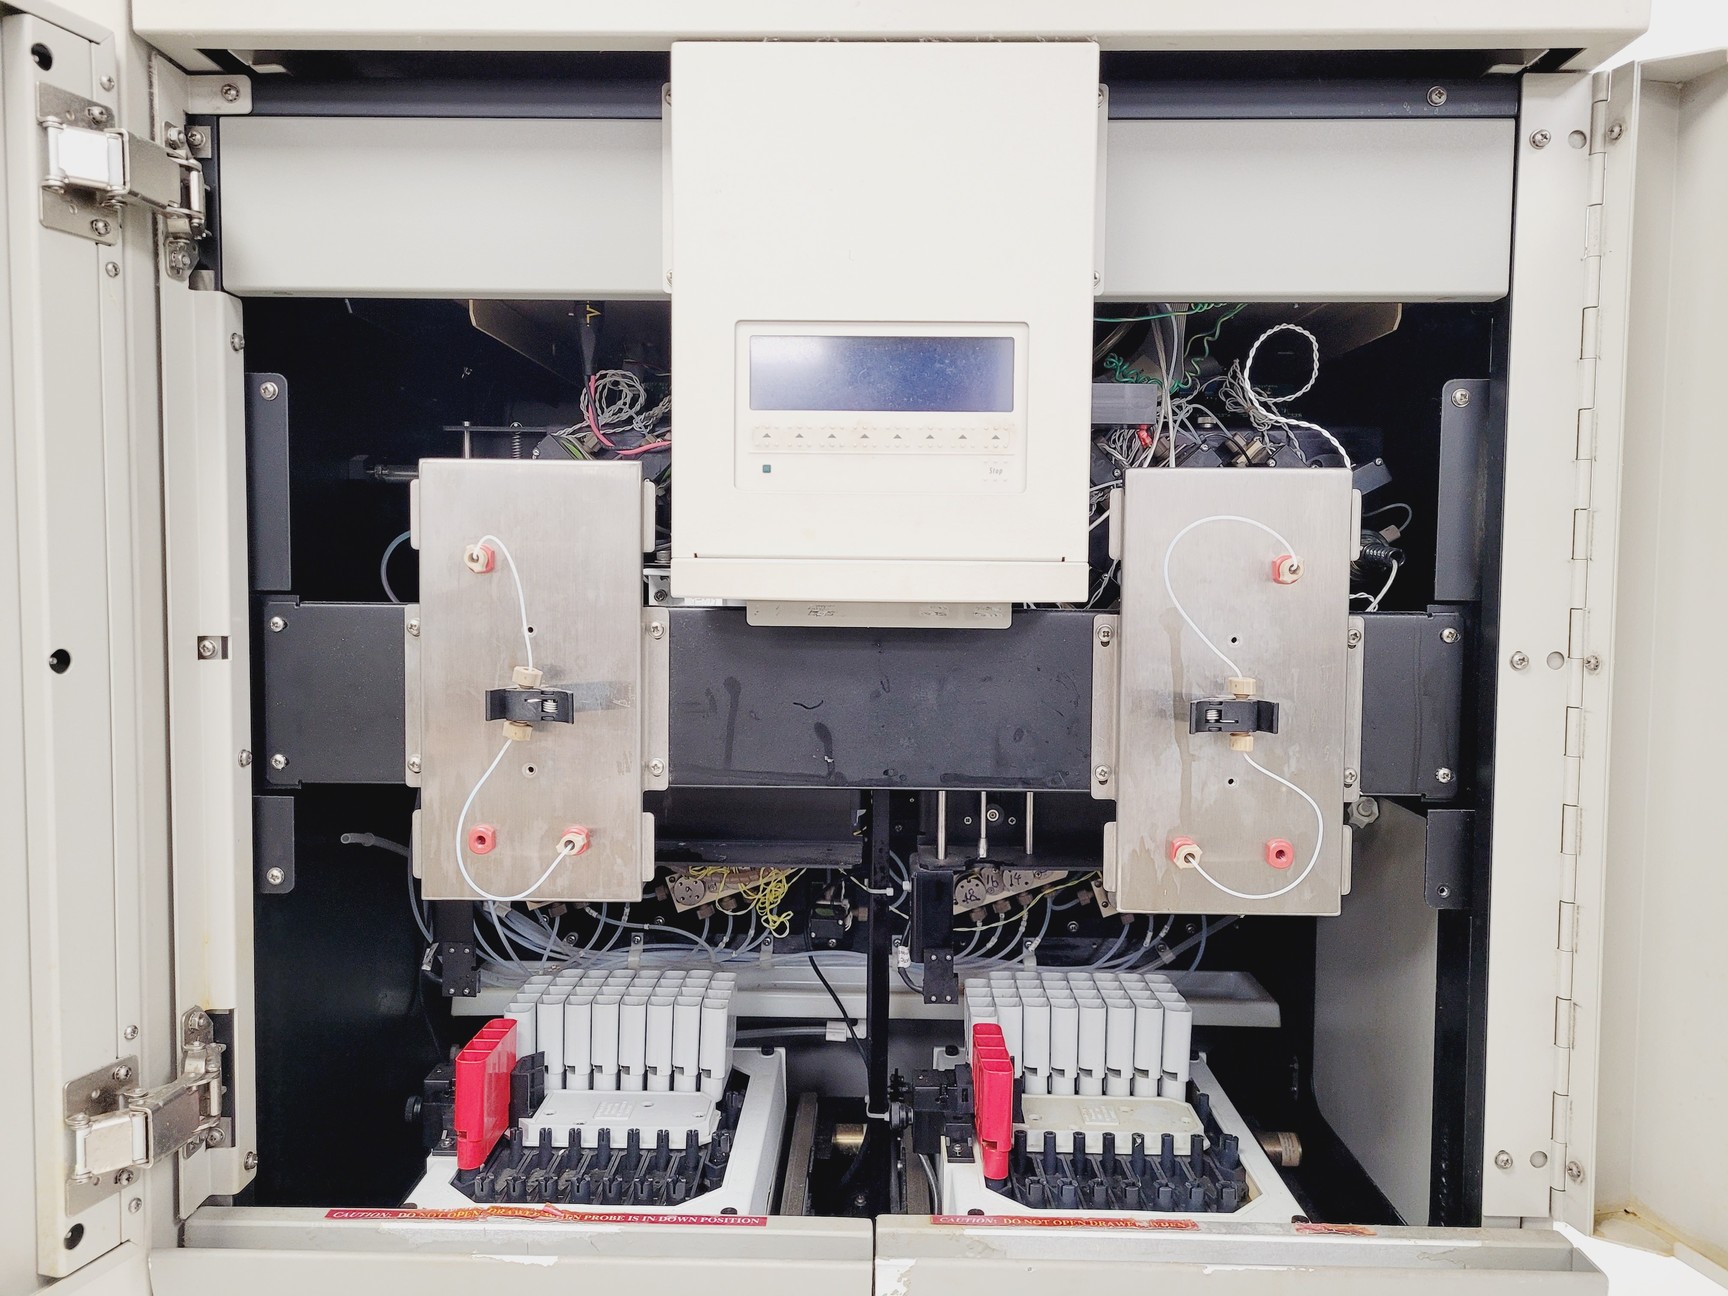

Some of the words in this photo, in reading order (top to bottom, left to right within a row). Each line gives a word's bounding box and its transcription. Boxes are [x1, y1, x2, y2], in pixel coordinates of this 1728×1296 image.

[988, 467, 1003, 476] Stop
[447, 1210, 481, 1218] OPEN
[658, 1215, 698, 1223] DOWN
[700, 1216, 760, 1224] POSITION
